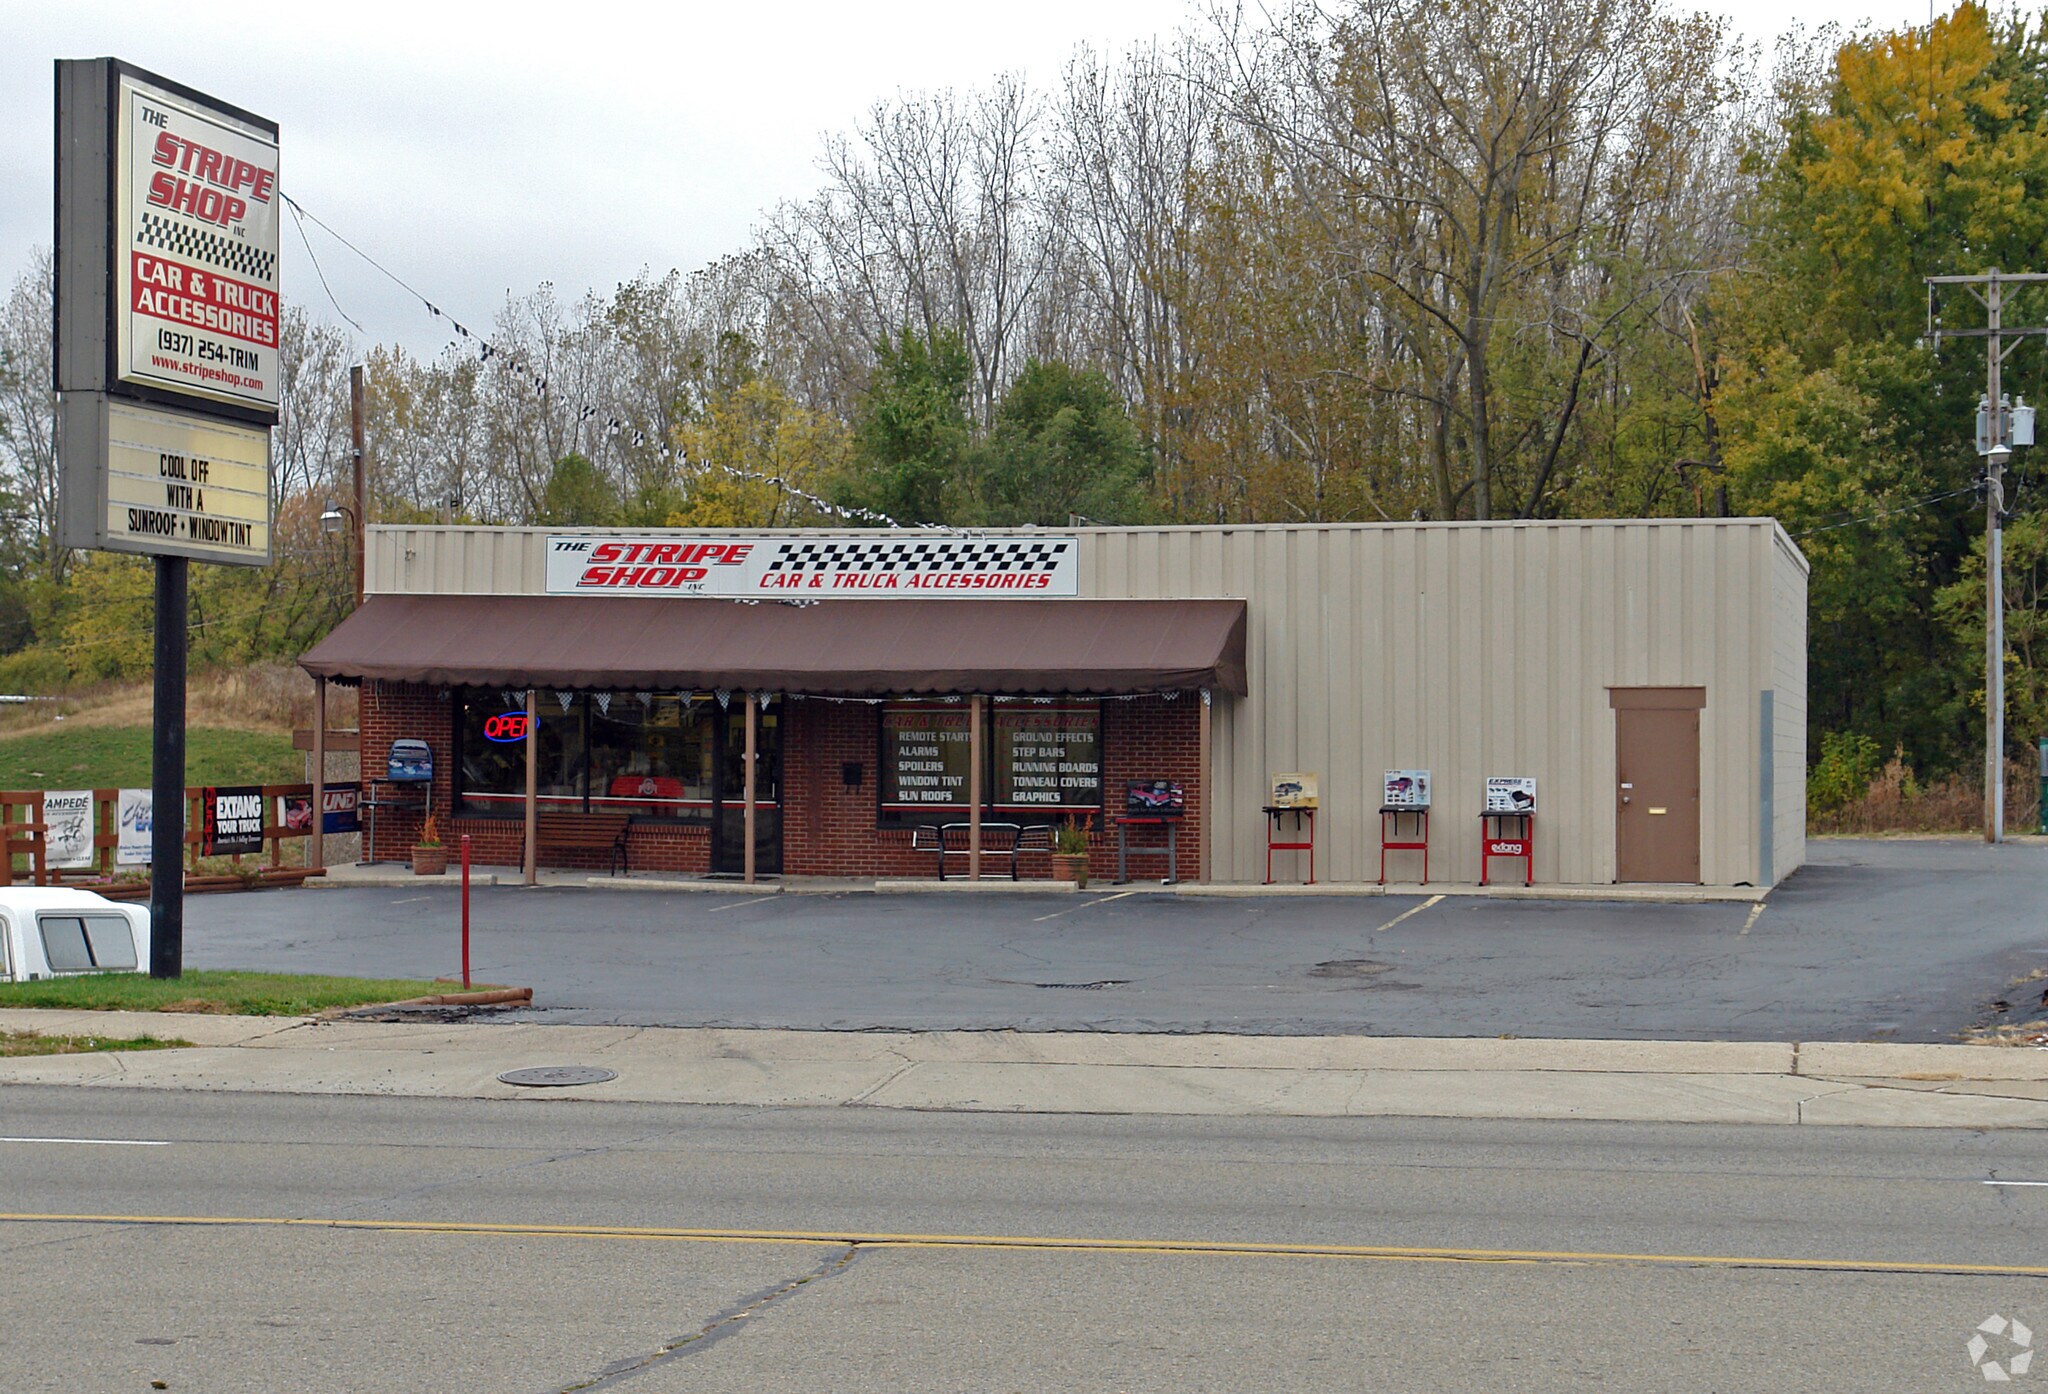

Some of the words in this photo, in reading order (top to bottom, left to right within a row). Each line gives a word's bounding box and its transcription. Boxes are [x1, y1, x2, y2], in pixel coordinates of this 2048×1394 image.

[141, 106, 169, 129] THE
[152, 130, 275, 204] STRIPE
[146, 170, 247, 229] SHOP
[233, 225, 246, 238] INC
[137, 257, 182, 292] CAR
[189, 273, 206, 298] &
[212, 277, 275, 318] TRUCK
[137, 287, 275, 344] ACCESSORIES
[158, 328, 194, 357] (937)
[198, 339, 259, 371] 254-TRIM
[151, 354, 264, 391] www.stripeshop.com
[160, 453, 187, 480] COOL
[191, 459, 209, 483] OFF
[167, 484, 193, 510] WITH
[196, 488, 204, 512] A
[128, 508, 177, 536] SUNROOF
[554, 542, 592, 551] THE
[586, 543, 754, 566] STRIPE
[576, 566, 709, 589] SHOP
[759, 573, 803, 589] CAR
[808, 573, 823, 588] &
[832, 573, 901, 589] TRUCK
[904, 573, 1052, 589] ACCESSORIES
[883, 714, 915, 728] CAR
[994, 714, 1100, 728] ACCESSORIES
[899, 731, 937, 742] REMOTE
[939, 731, 972, 742] START
[1012, 732, 1053, 742] GROUND
[1055, 733, 1094, 743] EFFECTS
[898, 746, 939, 757] ALARMS
[1012, 747, 1036, 758] STEP
[1039, 748, 1066, 758] BARS
[898, 761, 944, 772] SPOILERS
[1012, 762, 1056, 773] RUNNING
[1058, 763, 1099, 773] BOARDS
[898, 776, 939, 787] WINDOW
[941, 776, 964, 787] TINT
[1012, 777, 1058, 787] TONNEAU
[1060, 777, 1098, 788] COVERS
[44, 797, 89, 809] AMPEDE
[323, 792, 356, 811] UND
[898, 791, 919, 802] SUN
[921, 791, 953, 802] ROOFS
[1012, 792, 1061, 802] GRAPHICS
[216, 795, 262, 819] EXTANG
[217, 820, 238, 834] YOUR
[238, 819, 261, 833] TRUCK
